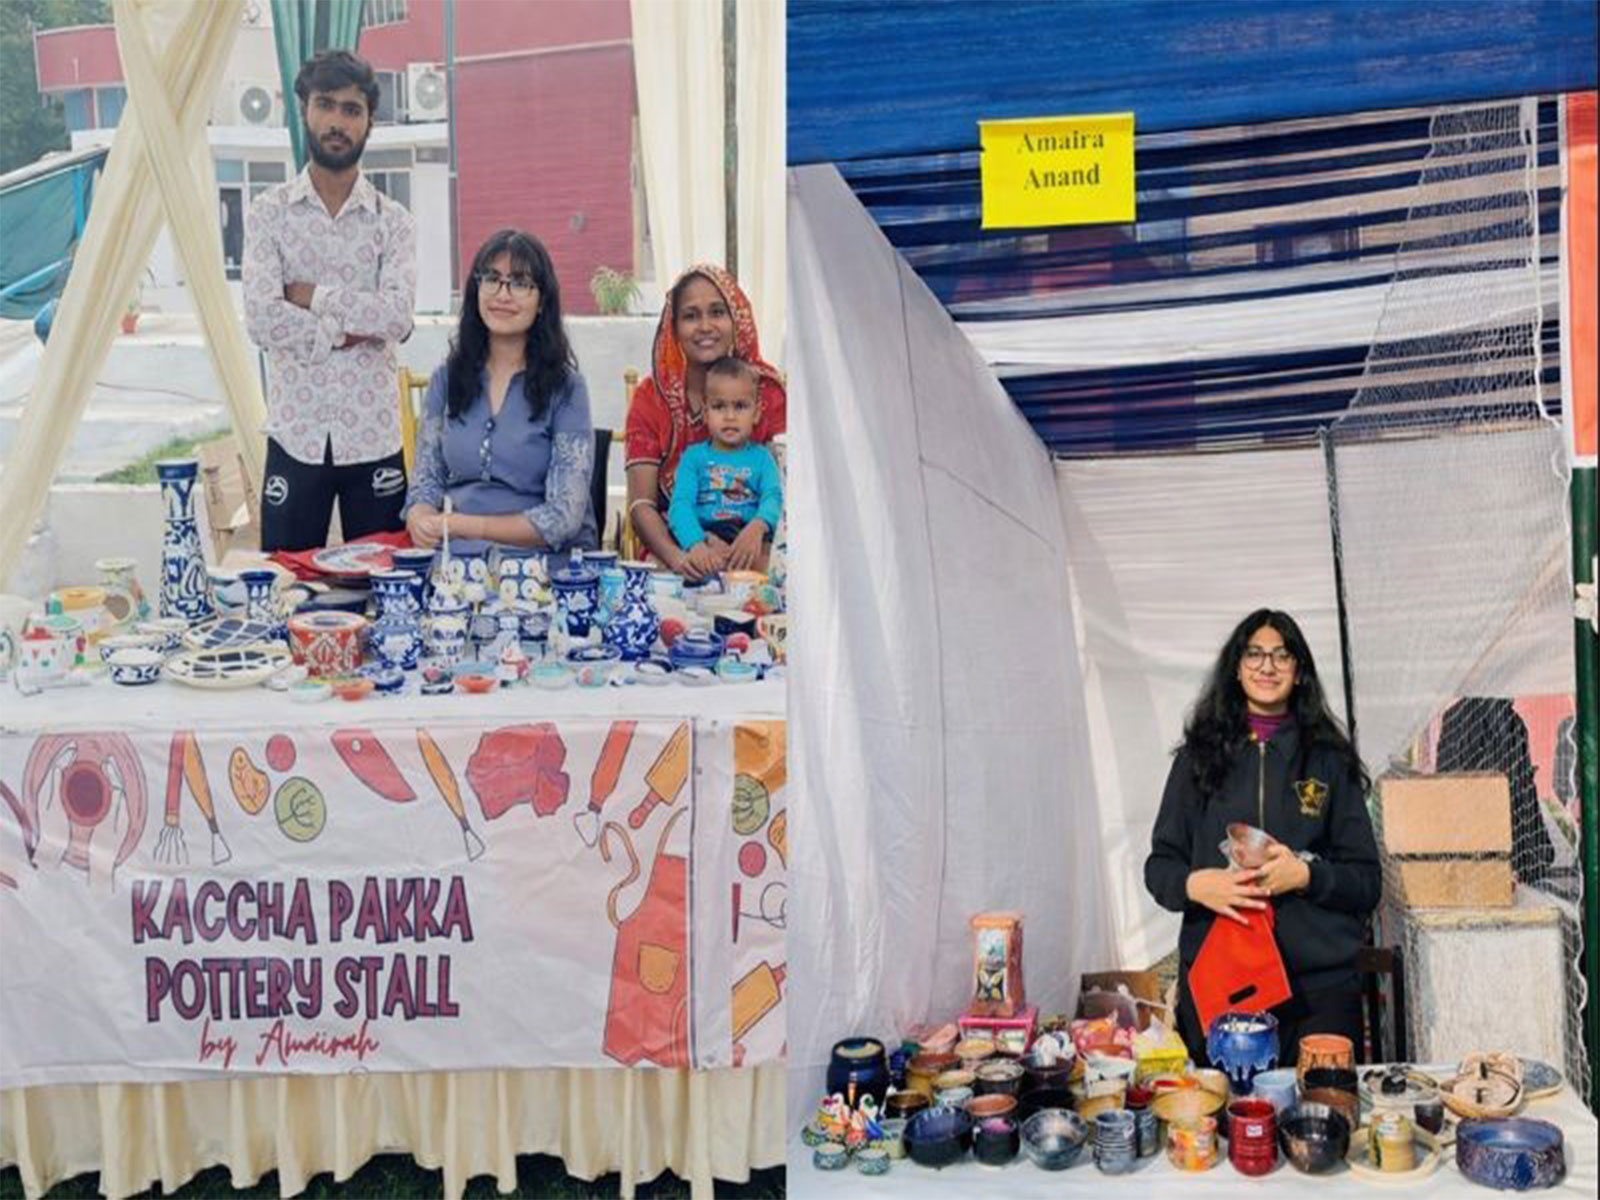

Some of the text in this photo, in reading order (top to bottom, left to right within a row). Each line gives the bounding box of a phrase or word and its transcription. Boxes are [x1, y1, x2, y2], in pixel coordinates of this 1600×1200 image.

[1017, 130, 1104, 154] Amaira
[1024, 164, 1100, 190] Anand
[131, 876, 474, 945] KACCHA PAKKA
[145, 953, 460, 1022] POTTERY STALL
[199, 1016, 379, 1069] by Amairah
